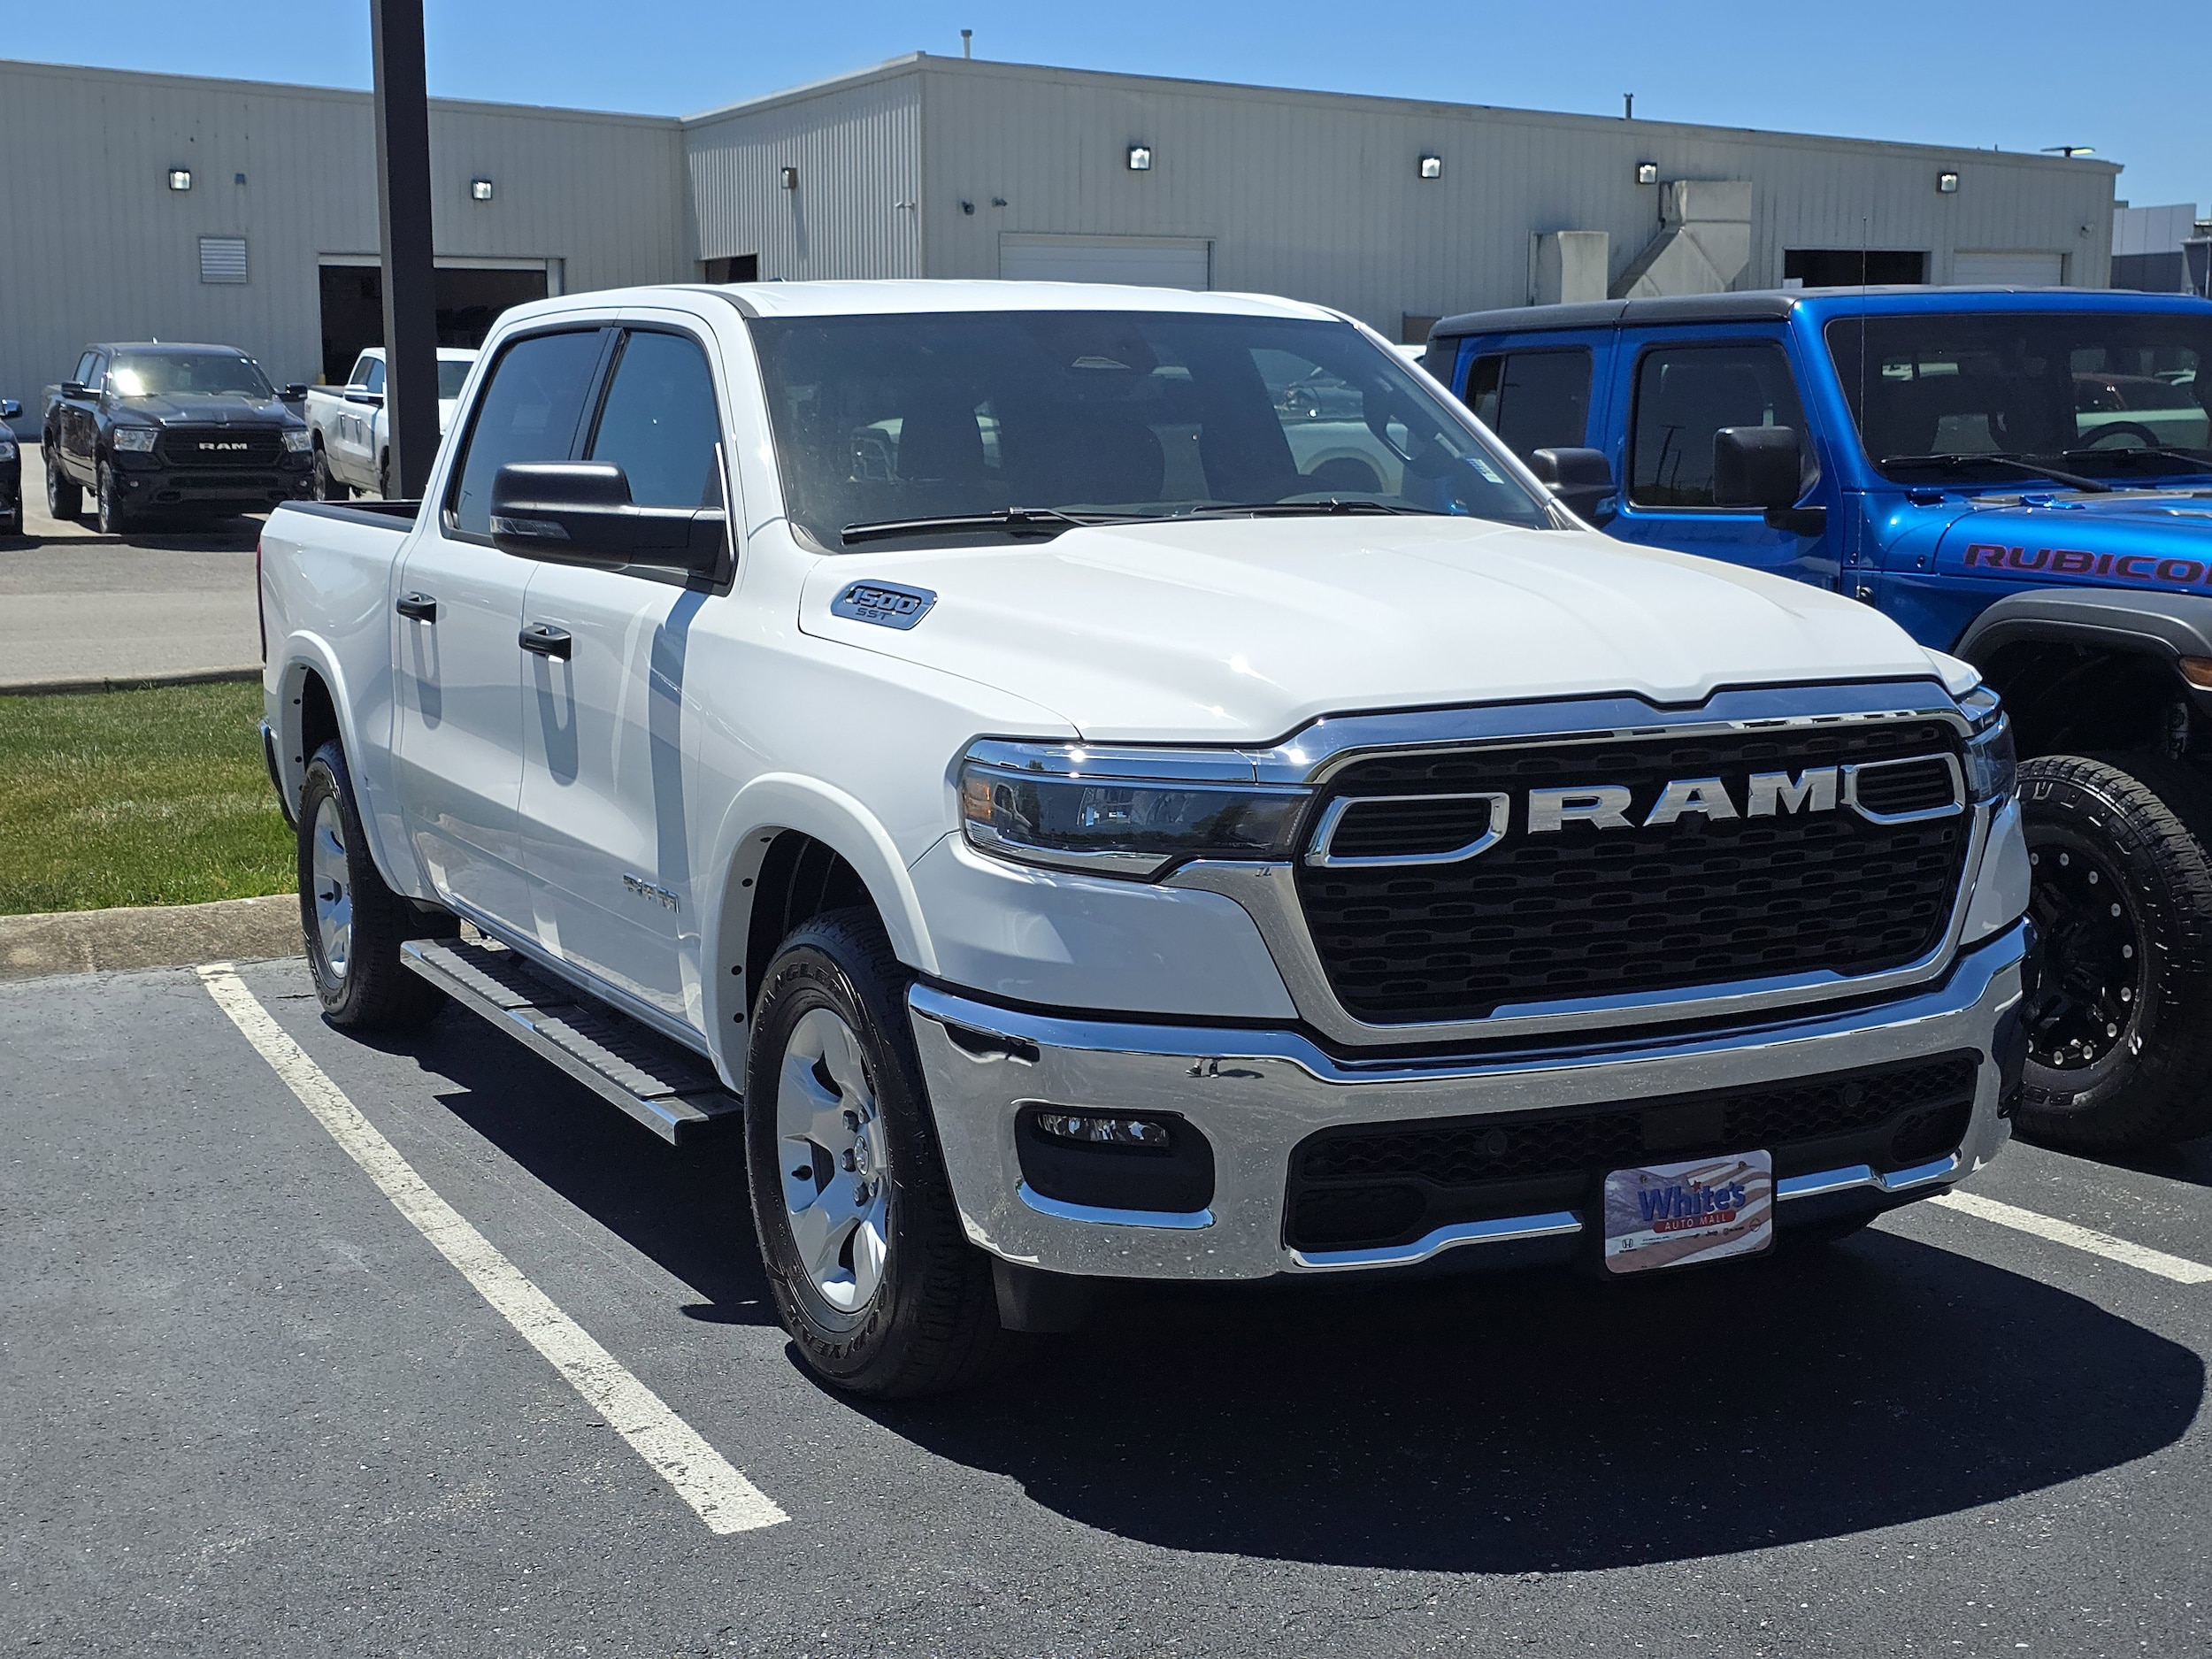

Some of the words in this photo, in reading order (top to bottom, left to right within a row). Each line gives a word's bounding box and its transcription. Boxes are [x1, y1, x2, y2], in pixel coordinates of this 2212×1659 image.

[1963, 543, 2212, 587] RUBICO
[851, 587, 919, 614] 1500
[856, 607, 893, 620] SST
[1528, 765, 1838, 834] RAM
[1639, 1181, 1746, 1221] White's
[1664, 1218, 1694, 1231] AUTO
[1699, 1213, 1727, 1225] MALL
